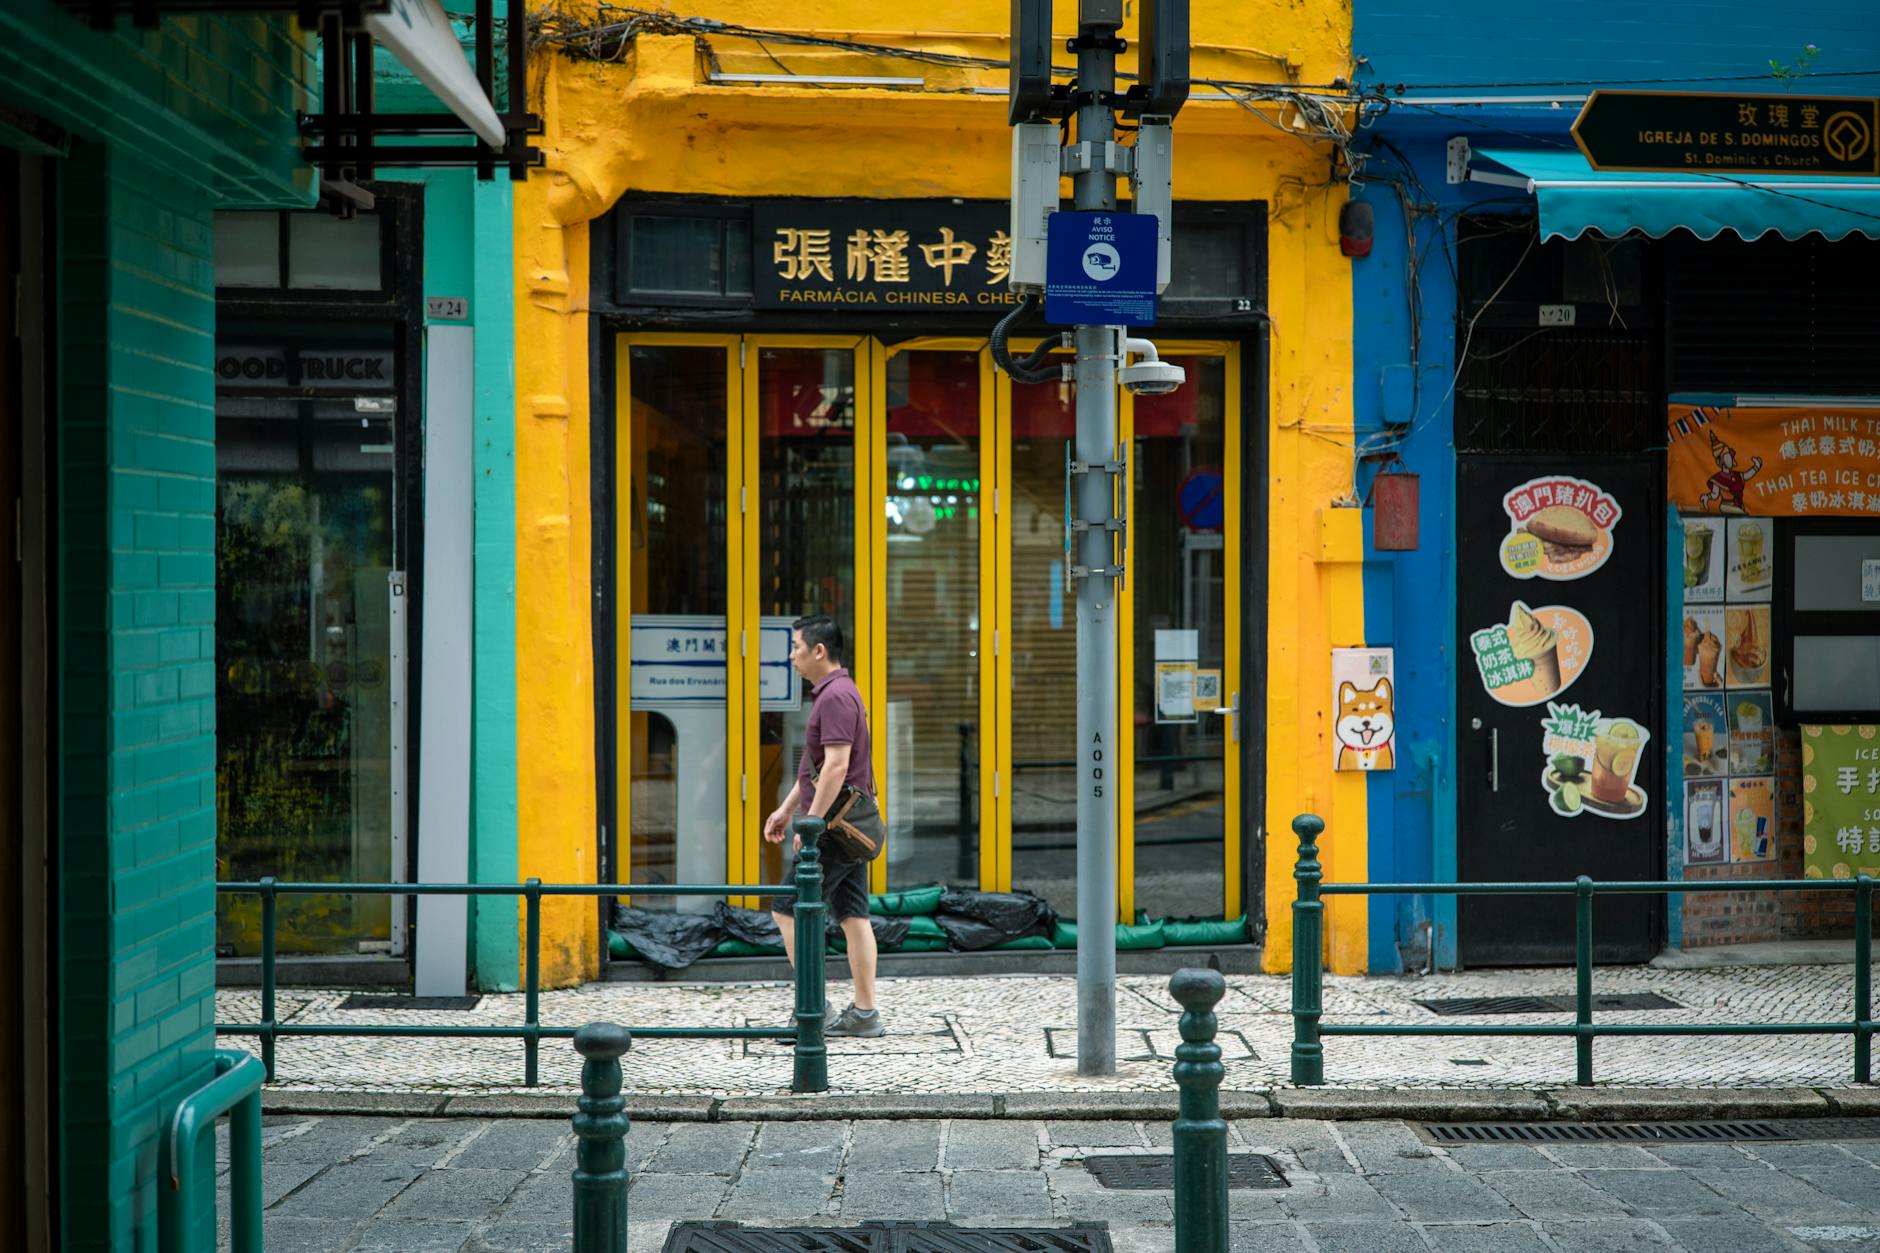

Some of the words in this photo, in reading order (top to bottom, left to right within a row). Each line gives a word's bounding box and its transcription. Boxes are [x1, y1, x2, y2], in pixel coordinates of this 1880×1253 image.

[1738, 103, 1820, 129] 玫瑰堂
[1638, 130, 1693, 145] IGREJA
[1699, 131, 1718, 145] DE
[1724, 132, 1737, 146] S.
[1742, 133, 1820, 148] DOMINGOS
[1684, 152, 1703, 164] St.
[1706, 153, 1769, 165] Dominic's
[1775, 153, 1820, 166] Church
[779, 287, 878, 304] FARMÁCIA
[885, 291, 970, 305] CHINESA
[1238, 300, 1251, 311] 22
[446, 300, 462, 316] 24
[1557, 308, 1571, 322] 20
[215, 357, 285, 379] OOD
[1780, 417, 1816, 437] THAI
[1823, 416, 1858, 433] MILK
[1779, 436, 1880, 460] 傳統泰式奶
[1755, 473, 1794, 497] THAI
[1799, 470, 1828, 486] TEA
[1835, 469, 1860, 486] ICE
[1512, 485, 1614, 524] 澳門豬扒包
[1476, 630, 1507, 651] 泰式
[1481, 648, 1513, 669] 奶茶
[649, 677, 667, 686] Rua
[668, 677, 685, 686] dos
[1487, 661, 1533, 687] 冰淇淋
[1557, 716, 1594, 739] 爆打
[1093, 732, 1103, 798] A005
[1855, 748, 1880, 761] ICE
